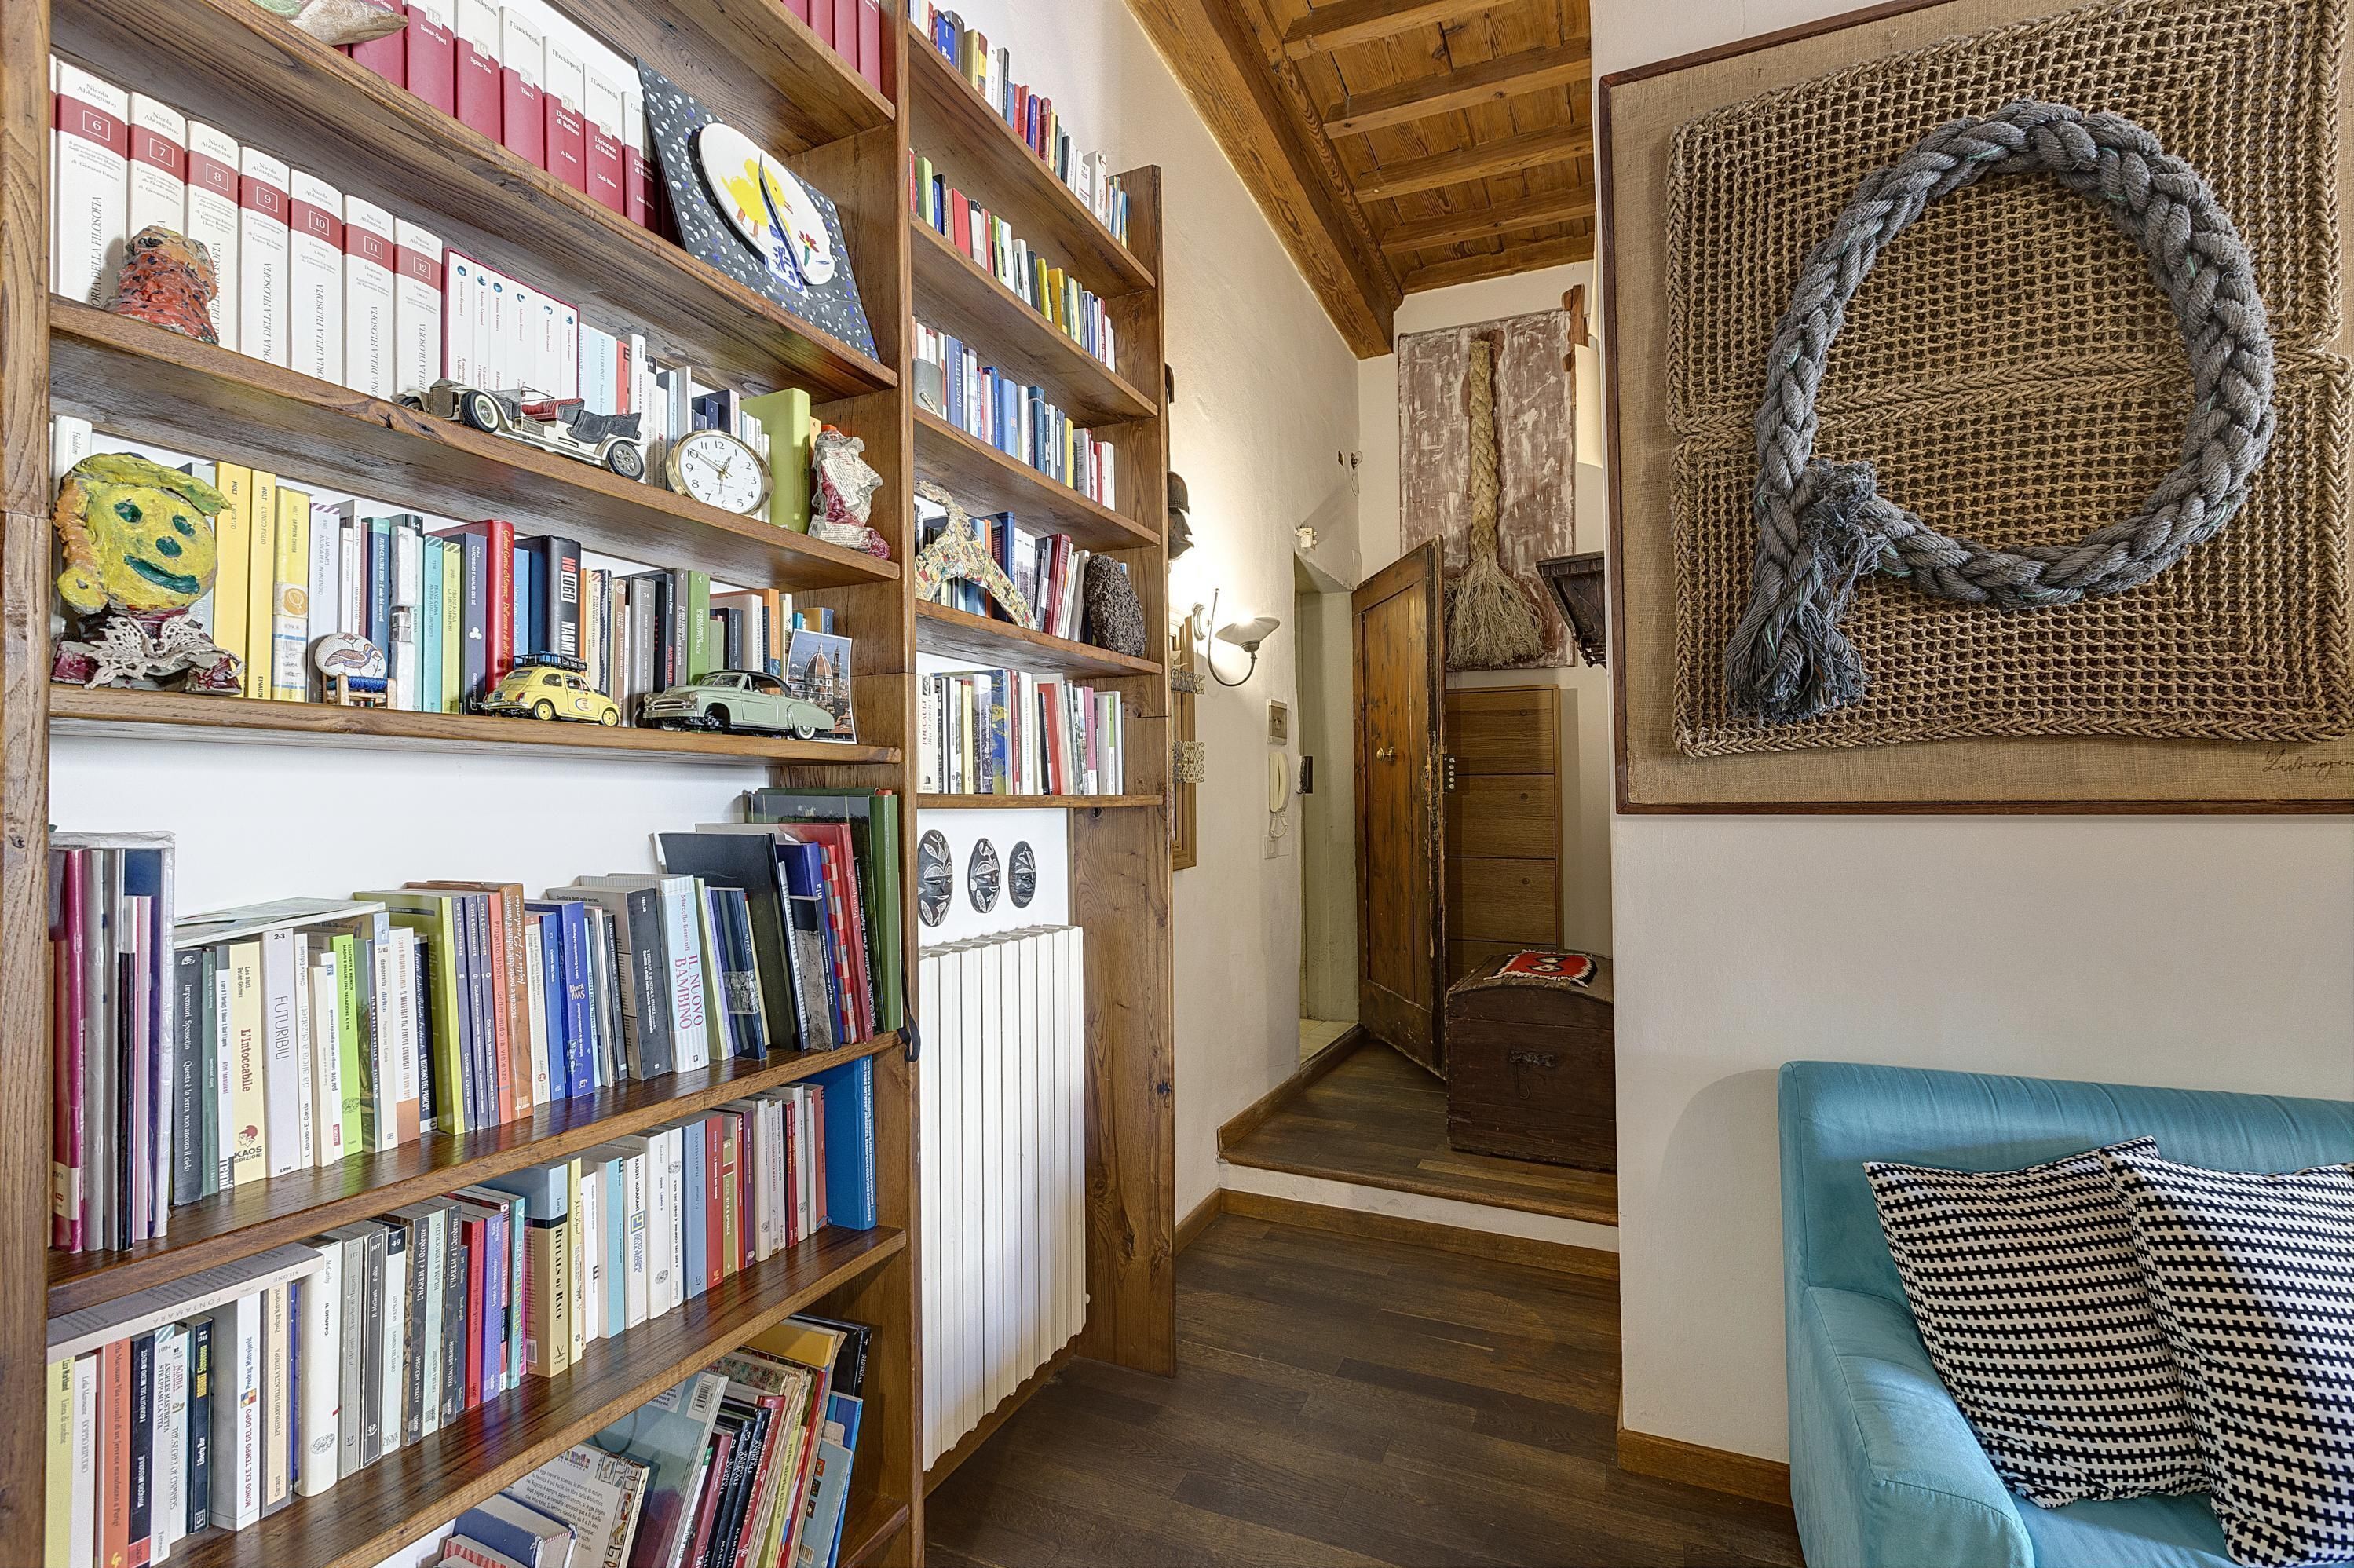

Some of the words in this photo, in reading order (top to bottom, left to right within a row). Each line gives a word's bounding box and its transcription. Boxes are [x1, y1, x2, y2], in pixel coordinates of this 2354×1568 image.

[552, 49, 583, 74] l'Enciclopedia
[77, 86, 117, 108] Abbagnano
[86, 82, 109, 99] Nicola
[590, 76, 618, 101] l'Enciclopedia
[92, 120, 102, 131] 6
[144, 114, 180, 136] Abbagnano
[152, 111, 173, 126] Nicola
[556, 109, 580, 130] Dizionario
[562, 120, 579, 137] Italiano
[157, 147, 166, 157] 7
[200, 140, 233, 161] Abbagnano
[207, 137, 227, 152] Nicola
[594, 136, 617, 154] Dizionario
[600, 146, 617, 161] Italiano
[213, 170, 222, 182] 8
[263, 194, 272, 204] 9
[91, 196, 102, 247] FILOSOFIA
[314, 217, 326, 228] 10
[368, 241, 378, 253] 11
[90, 247, 101, 280] DELLA
[419, 262, 428, 273] 12
[263, 263, 272, 308] FILOSOFIA
[263, 309, 272, 338] DELLA
[371, 306, 379, 347] FILOSOFIA
[71, 431, 82, 455] Haddon
[715, 440, 726, 450] 12
[685, 462, 693, 473] 9
[744, 461, 751, 470] 2
[691, 479, 700, 488] 8
[750, 476, 757, 485] 3
[737, 498, 744, 507] 5
[747, 490, 755, 499] 4
[561, 556, 576, 572] NO
[562, 574, 576, 600] LOGO
[561, 620, 576, 656] NAOMI
[849, 875, 860, 919] Principesse
[504, 895, 513, 927] d'America
[680, 894, 689, 923] Marcello
[859, 907, 868, 931] Mythe
[513, 894, 523, 948] Pocahontas
[493, 920, 503, 954] Progetto
[682, 924, 691, 952] Bernardi
[516, 958, 525, 985] figlie
[688, 954, 698, 969] IL
[507, 967, 517, 987] poesie
[183, 984, 192, 1018] Imperatori,
[674, 957, 693, 1030] BAMBINO
[689, 974, 704, 1027] NUOVO
[497, 991, 506, 1036] Gener-ando
[508, 992, 517, 1018] racconti
[275, 996, 290, 1060] FUTURIBILI
[299, 1001, 308, 1042] elizabeth
[183, 1019, 192, 1050] Spessotto
[240, 1029, 253, 1092] L'Intoccabile
[300, 1052, 309, 1076] alicia
[419, 1059, 428, 1080] RITORNO
[182, 1060, 192, 1084] Questa
[183, 1097, 192, 1114] terra,
[422, 1090, 430, 1113] PRINCIPE
[234, 1146, 262, 1158] KAOS
[235, 1153, 262, 1163] EDIZIONI
[183, 1157, 192, 1172] cielo
[391, 1237, 401, 1247] 49
[451, 1217, 459, 1251] l'Occidente
[419, 1228, 427, 1263] l'Occidente
[555, 1228, 564, 1276] RITUALS
[273, 1270, 299, 1283] SILONE
[152, 1297, 221, 1325] FONTAMARA
[555, 1291, 564, 1322] RACE
[198, 1344, 207, 1372] Simenon
[744, 1431, 751, 1441] 3
[196, 1447, 207, 1467] Liberty
